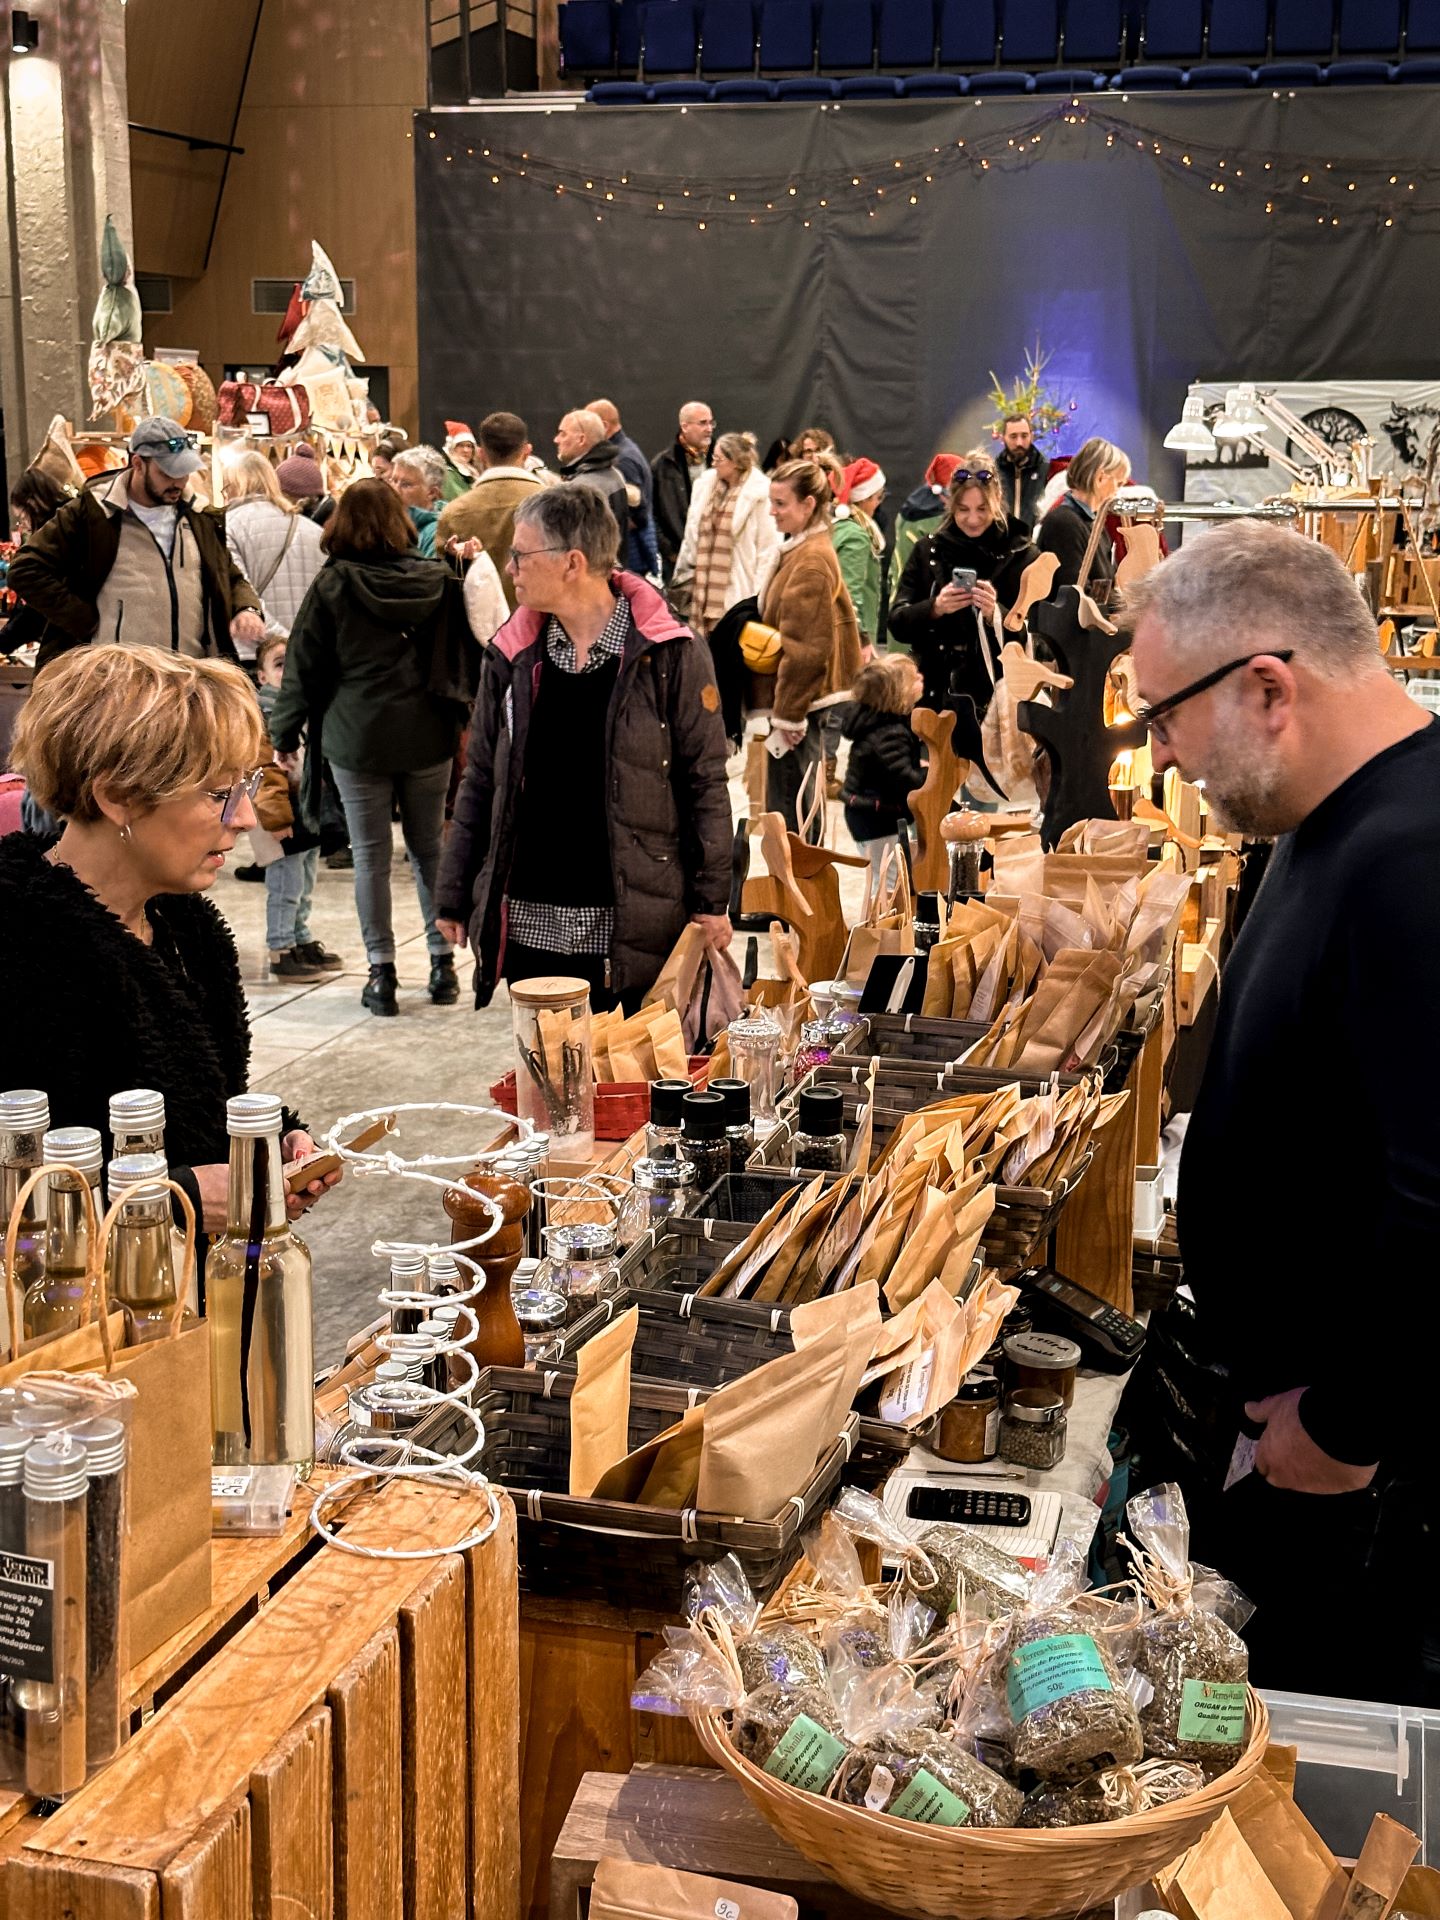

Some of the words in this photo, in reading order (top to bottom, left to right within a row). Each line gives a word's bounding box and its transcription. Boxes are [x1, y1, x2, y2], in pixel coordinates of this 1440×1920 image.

[3, 1556, 44, 1575] Terres
[2, 1567, 49, 1586] Vanille
[28, 1594, 43, 1606] 28g
[20, 1605, 34, 1616] 30g
[15, 1615, 30, 1627] 20g
[15, 1627, 30, 1639] 20g
[1037, 1658, 1048, 1666] de
[1047, 1682, 1065, 1693] 50g
[1194, 1701, 1220, 1711] ORIGAN
[1216, 1724, 1228, 1735] 40g
[784, 1730, 806, 1754] Vanille
[794, 1733, 818, 1765] Provence
[804, 1773, 818, 1788] 40g
[903, 1787, 926, 1812] Vanille
[914, 1791, 939, 1820] Provence
